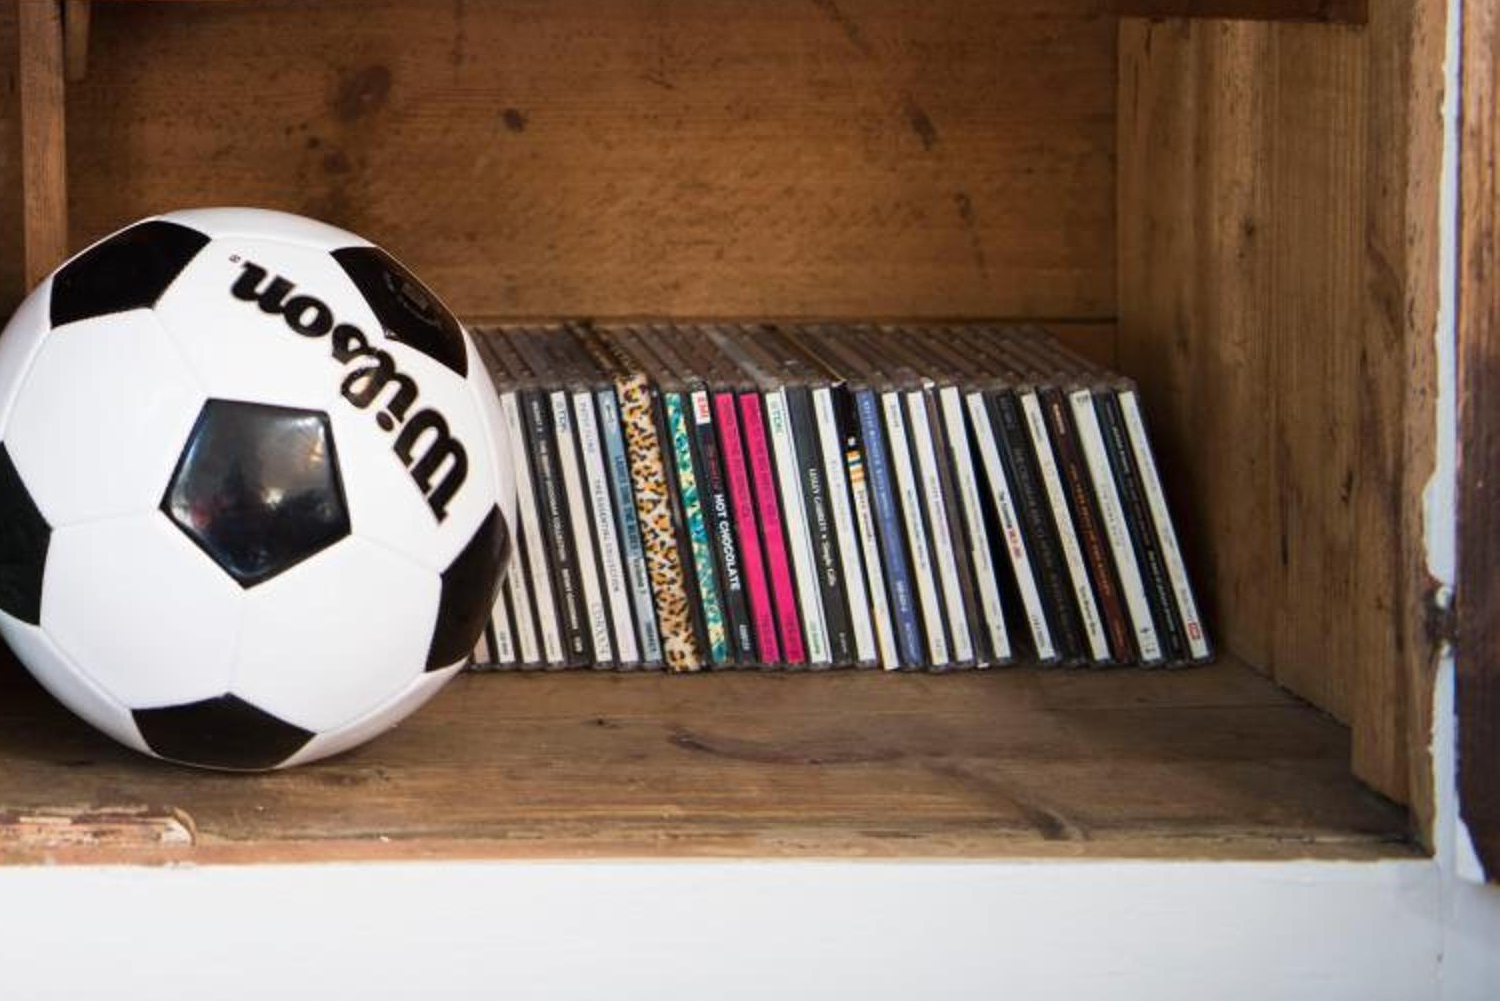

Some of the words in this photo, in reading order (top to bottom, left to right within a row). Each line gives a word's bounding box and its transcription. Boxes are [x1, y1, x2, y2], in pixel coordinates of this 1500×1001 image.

[229, 259, 469, 526] Wilson
[713, 493, 729, 521] HOT
[716, 522, 741, 593] CHOCOLATE
